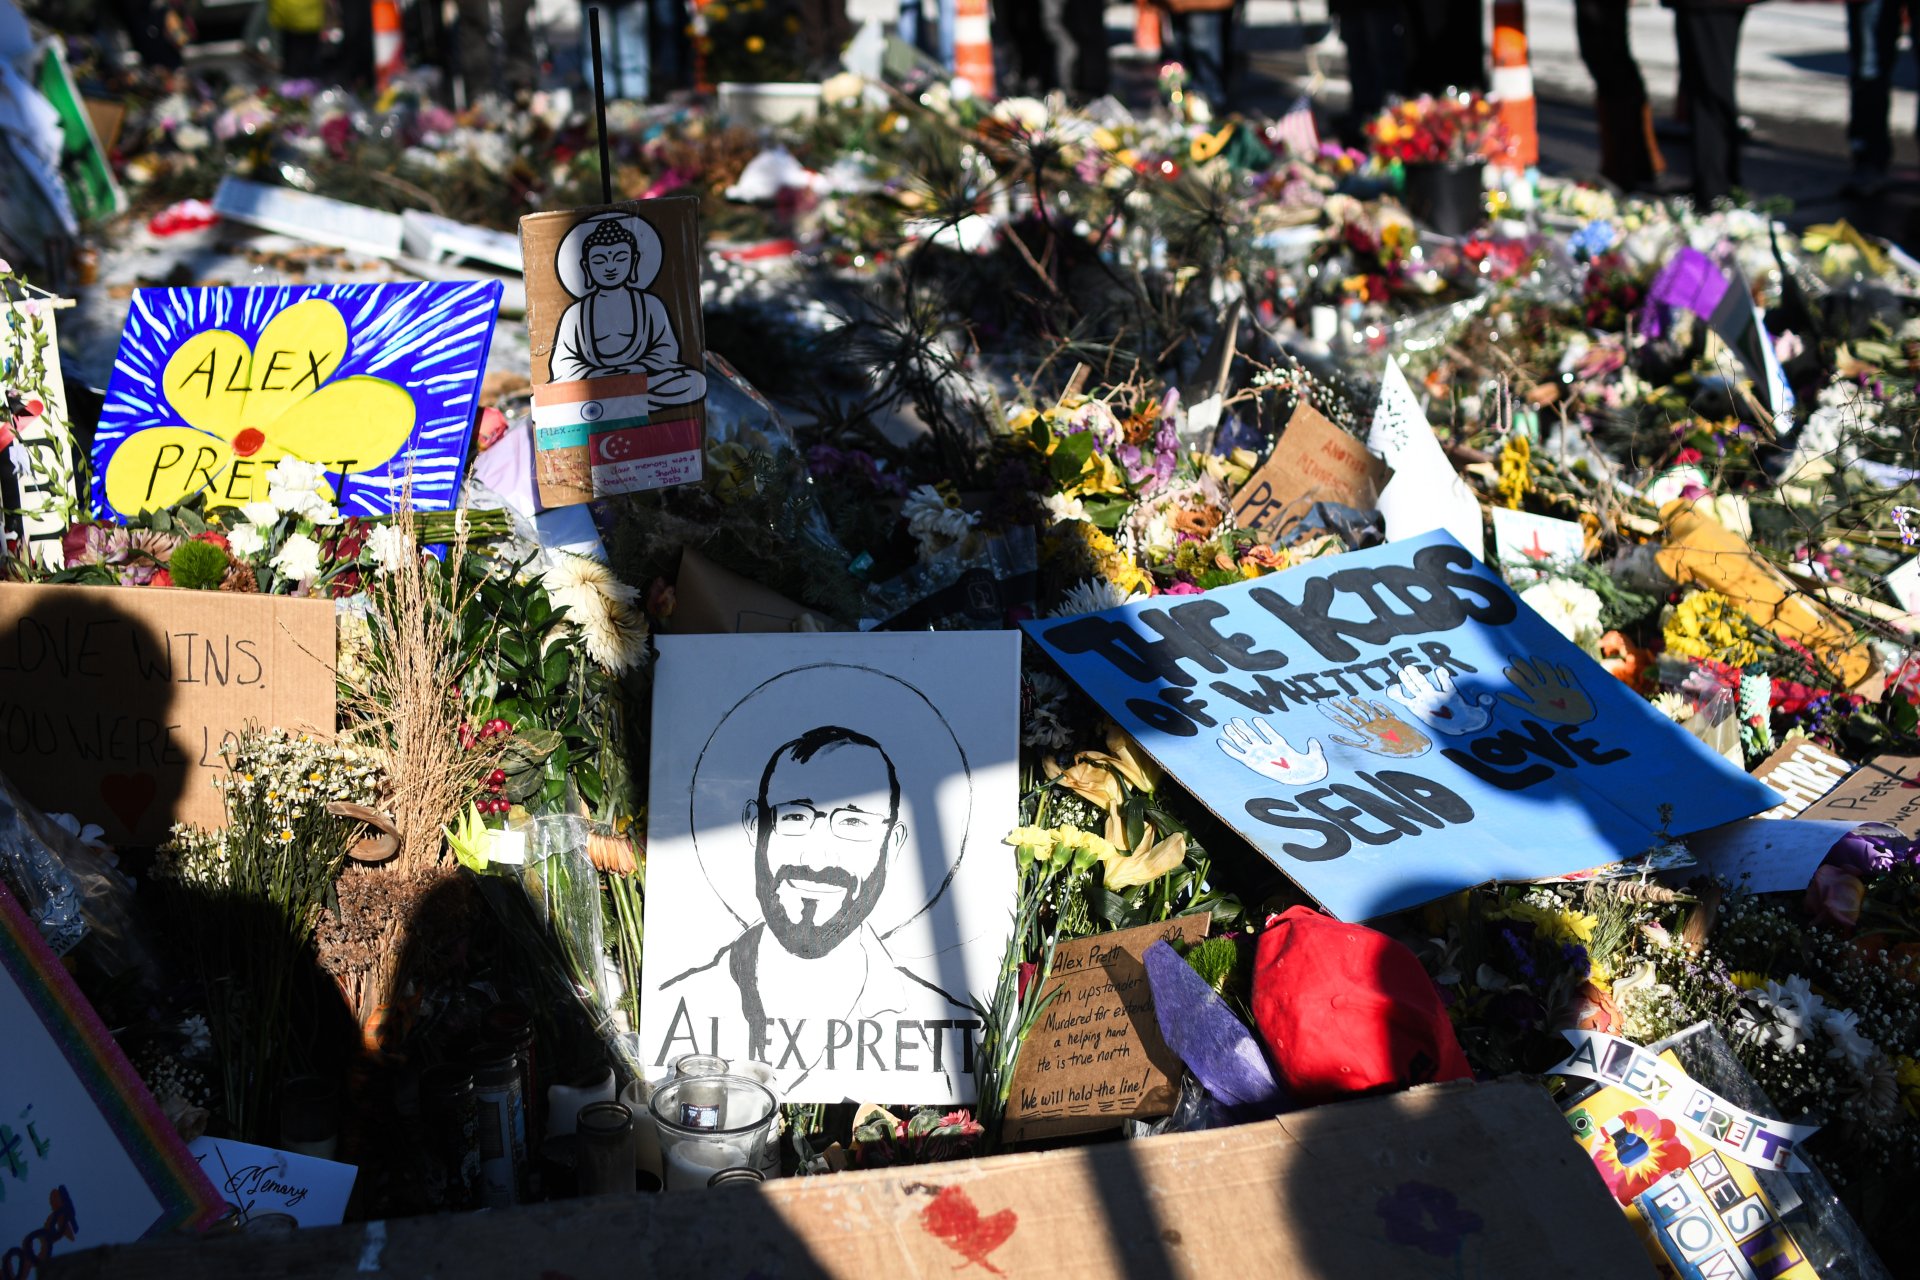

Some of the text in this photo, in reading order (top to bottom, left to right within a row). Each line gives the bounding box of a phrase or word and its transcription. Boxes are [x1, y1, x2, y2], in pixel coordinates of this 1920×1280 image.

[180, 347, 332, 399] ALEX
[635, 460, 667, 471] memory
[1043, 544, 1518, 687] THE KIDS
[0, 616, 266, 689] OVE WINS.
[1125, 687, 1219, 737] OF
[66, 711, 188, 768] WERE
[1245, 719, 1631, 862] SEND LOVE
[1050, 951, 1084, 974] Alex
[1078, 973, 1144, 1008] upstander
[648, 996, 982, 1073] ALEX PRETT
[1044, 1008, 1094, 1033] Murdered
[1094, 1006, 1110, 1021] for
[1053, 1023, 1129, 1050] a helping hand
[1037, 1042, 1130, 1073] He is true north
[1021, 1067, 1151, 1111] We will hold the line!
[1567, 1036, 1793, 1170] ALEX PRETTI
[225, 1166, 309, 1207] Memory
